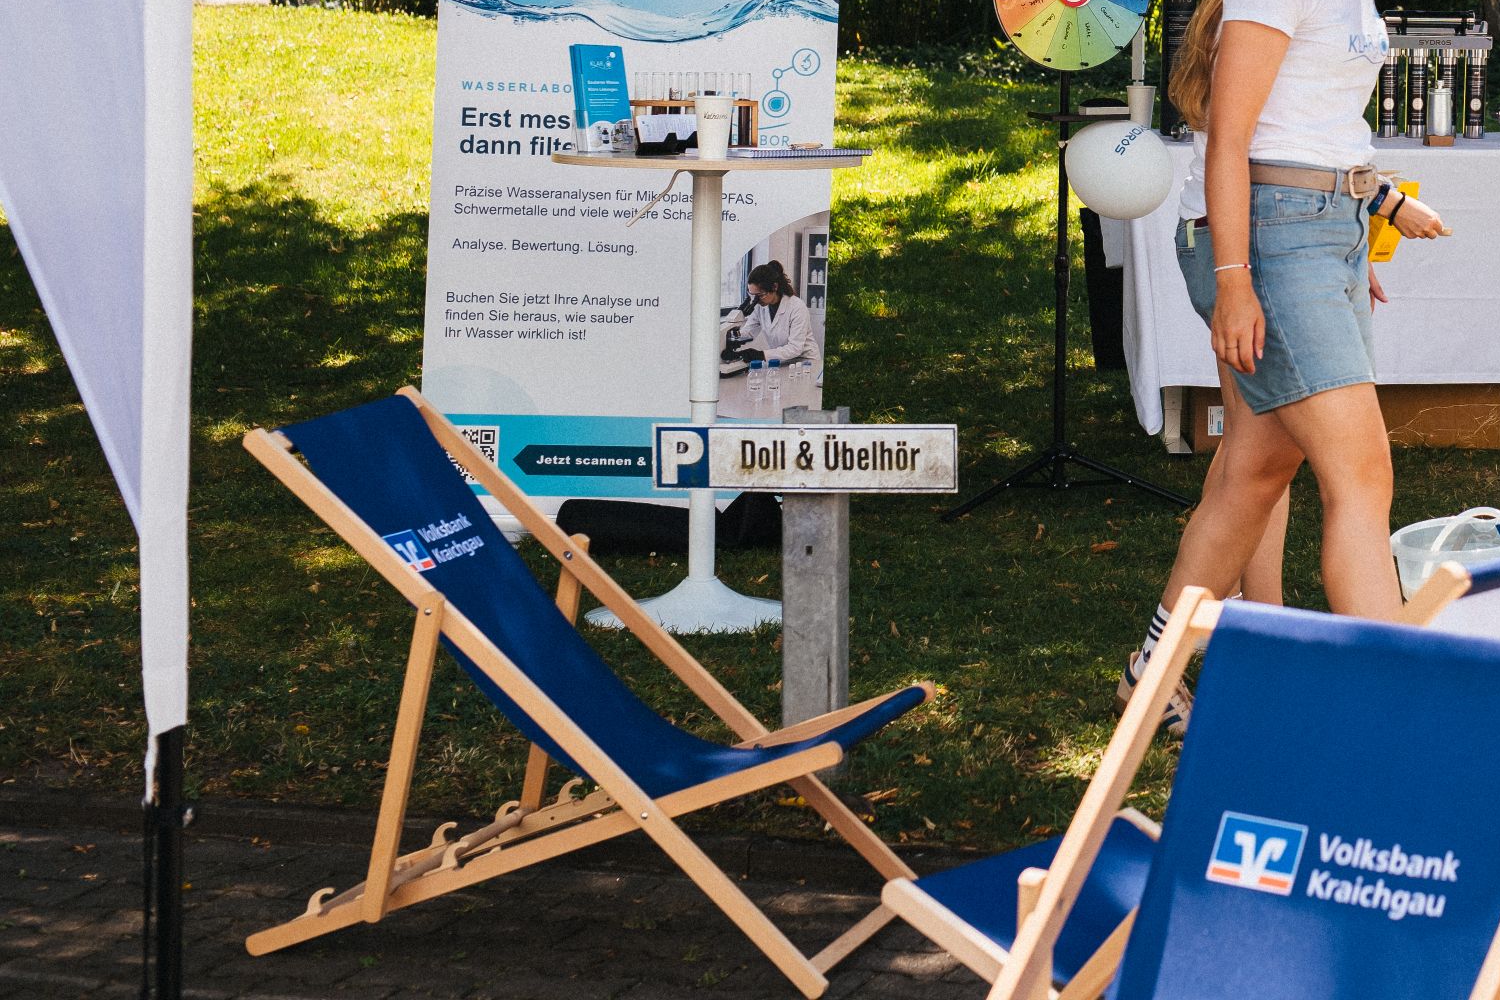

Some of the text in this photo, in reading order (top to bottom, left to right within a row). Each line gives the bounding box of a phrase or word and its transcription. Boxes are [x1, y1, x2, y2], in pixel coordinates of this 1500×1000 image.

[1418, 39, 1452, 47] SYDROS
[461, 80, 573, 94] WASSERLABO
[460, 106, 512, 129] Erst
[459, 134, 521, 155] dann
[454, 184, 633, 203] Präzise Wasseranalysen für
[451, 237, 638, 257] Analyse. Bewertung. Lösung.
[445, 290, 660, 309] Buchen Sie jetzt Ihre Analyse und
[444, 325, 587, 341] Ihr Wasser wirklich ist!
[535, 454, 647, 467] Jetzt scannen &
[660, 430, 704, 485] P
[740, 433, 921, 472] Doll & Übelhör
[417, 512, 473, 544] Volksbank
[431, 535, 485, 564] Kraichgau
[1318, 832, 1460, 882] Volksbank
[1306, 869, 1447, 921] Kraichgau
